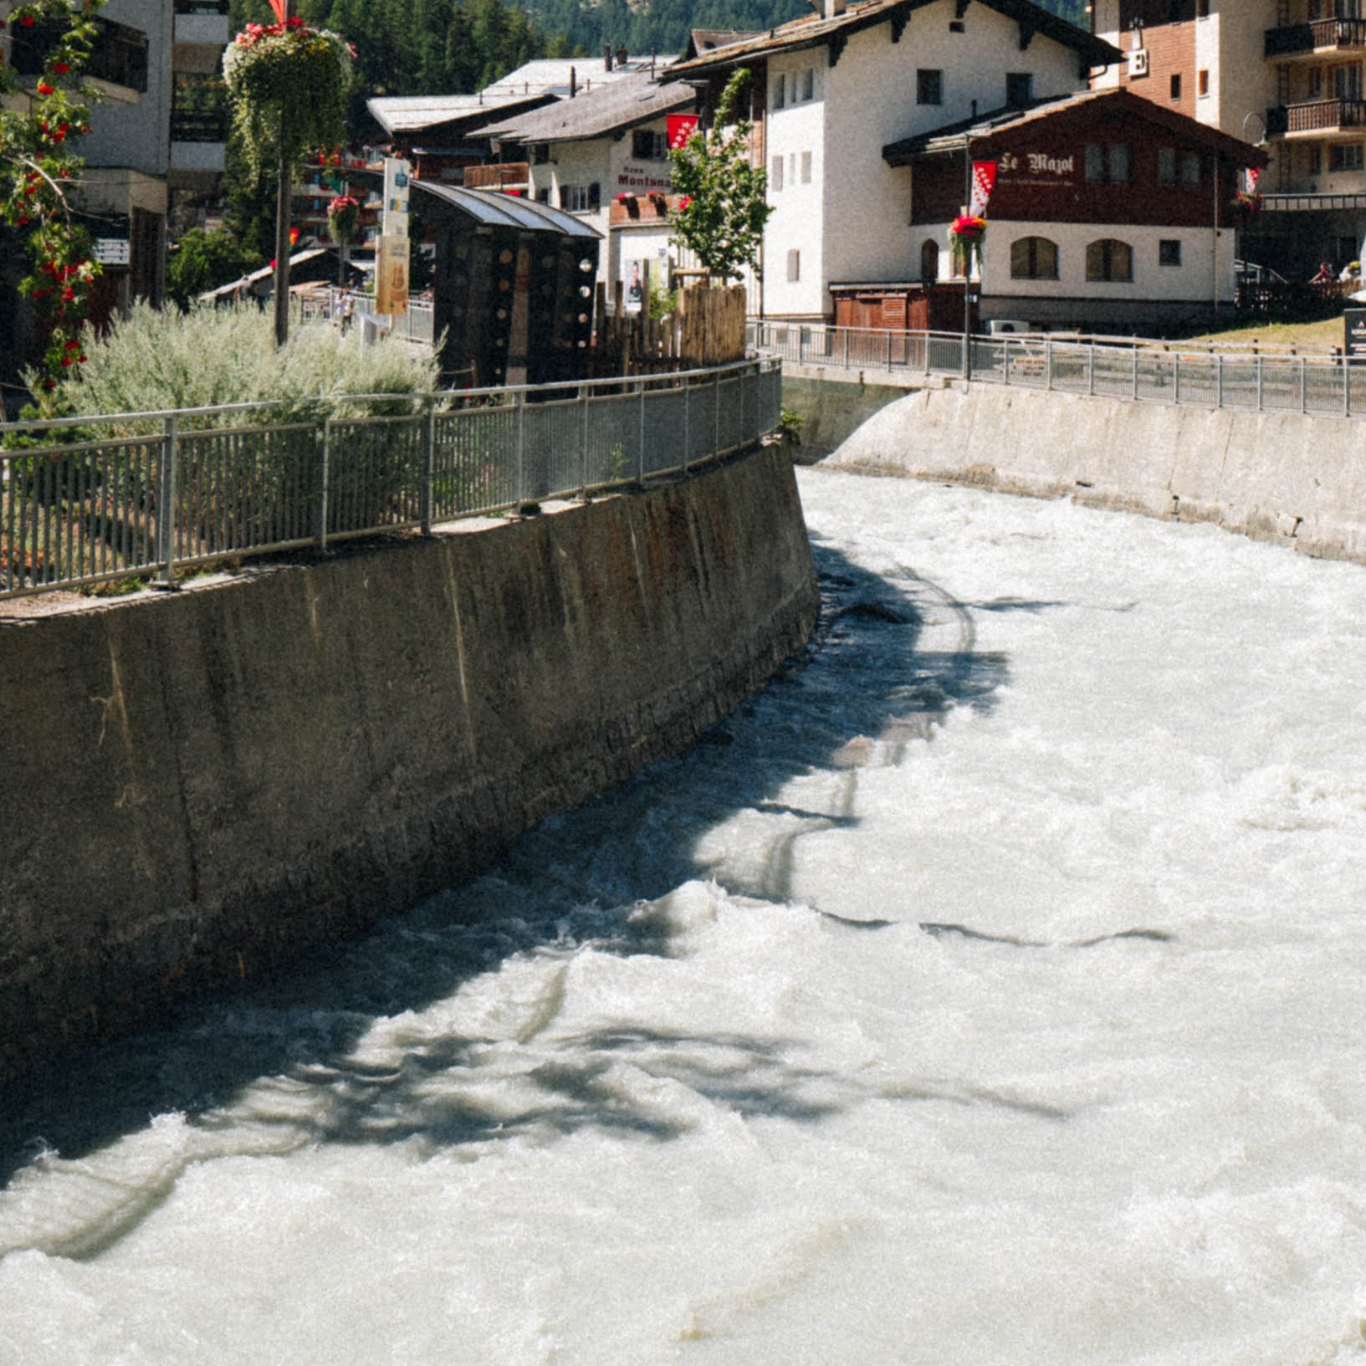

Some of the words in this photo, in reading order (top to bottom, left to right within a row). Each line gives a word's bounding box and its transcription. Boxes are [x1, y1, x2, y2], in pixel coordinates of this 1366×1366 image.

[623, 165, 644, 174] Haus
[997, 152, 1018, 173] Le
[1027, 153, 1074, 175] Mazot
[618, 175, 671, 187] Montana
